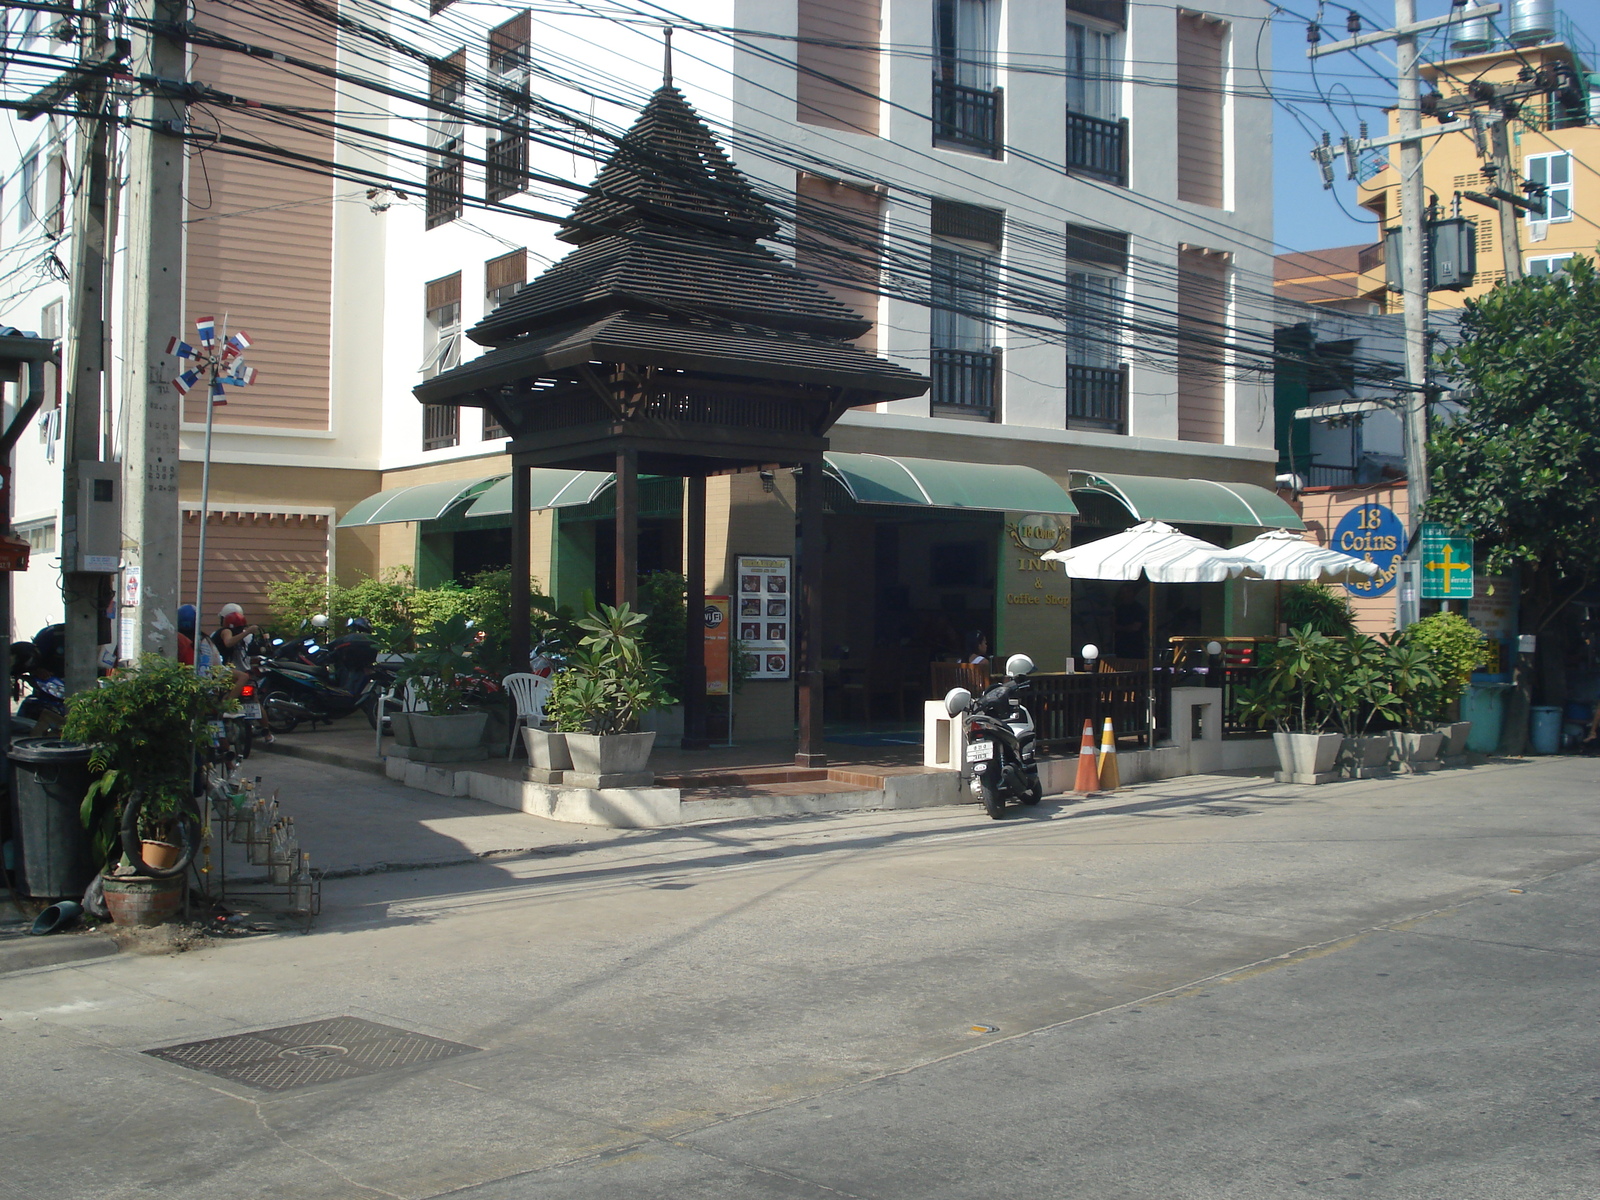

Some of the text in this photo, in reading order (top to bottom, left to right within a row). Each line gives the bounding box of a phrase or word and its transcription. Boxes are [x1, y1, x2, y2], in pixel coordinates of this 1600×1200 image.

[1357, 508, 1381, 530] 18
[1340, 531, 1396, 551] Coins
[1019, 558, 1058, 571] INN
[1034, 577, 1043, 589] &
[1007, 593, 1070, 608] Coffee Shop
